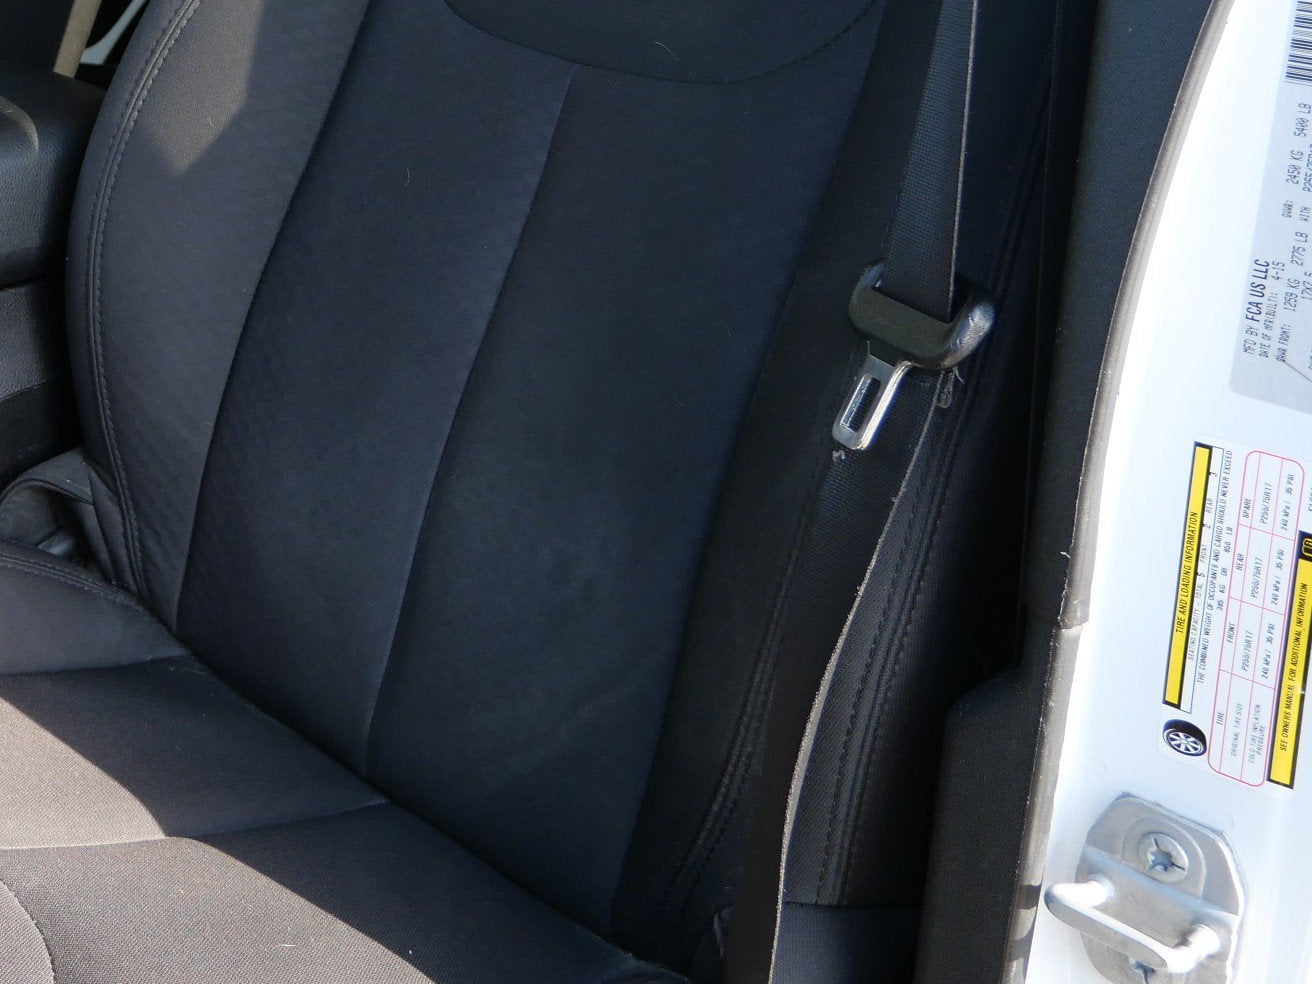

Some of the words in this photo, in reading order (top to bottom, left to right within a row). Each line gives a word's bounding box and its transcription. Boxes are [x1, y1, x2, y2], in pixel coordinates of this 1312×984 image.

[1297, 101, 1311, 115] LB
[1292, 115, 1309, 138] 5400
[1289, 148, 1304, 162] KG
[1285, 163, 1301, 185] 2450
[1293, 230, 1308, 243] LB
[1290, 244, 1305, 266] 2775
[1251, 258, 1270, 280] LLC
[1269, 259, 1285, 281] 4-15
[1248, 280, 1266, 298] US
[1286, 277, 1300, 289] KG
[1244, 298, 1263, 322] FCA
[1282, 290, 1298, 312] 1259
[1244, 324, 1259, 336] BY
[1260, 331, 1272, 341] OF
[1241, 337, 1257, 355] MFD
[1258, 342, 1271, 358] DATE
[1222, 448, 1233, 475] EXCEED
[1219, 475, 1229, 498] NEVER
[1284, 485, 1293, 496] 35
[1216, 497, 1227, 525] SHOULD
[1241, 496, 1251, 519] SPARE
[1184, 510, 1198, 563] INFORMATION
[1213, 523, 1223, 548] CARGO
[1225, 525, 1233, 536] LB
[1199, 542, 1207, 563] FRONT
[1211, 547, 1220, 562] AND
[1235, 551, 1244, 571] REAR
[1220, 565, 1228, 577] OR
[1275, 560, 1283, 571] 35
[1179, 563, 1192, 598] LOADING
[1206, 562, 1219, 601] OCCUPANTS
[1217, 582, 1226, 594] KG
[1177, 597, 1187, 615] AND
[1205, 601, 1214, 611] OF
[1294, 581, 1308, 628] INFORMATION
[1175, 615, 1185, 634] TIRE
[1202, 610, 1212, 636] WEIGHT
[1225, 621, 1236, 644] FRONT
[1265, 634, 1273, 645] 35
[1289, 628, 1302, 667] ADDITIONAL
[1198, 636, 1209, 671] COMBINED
[1196, 671, 1205, 684] THE
[1287, 666, 1297, 682] FOR
[1284, 682, 1295, 711] MANUAL
[1215, 710, 1224, 726] TIRE
[1280, 709, 1291, 739] OWNERS
[1279, 738, 1288, 752] SEE
